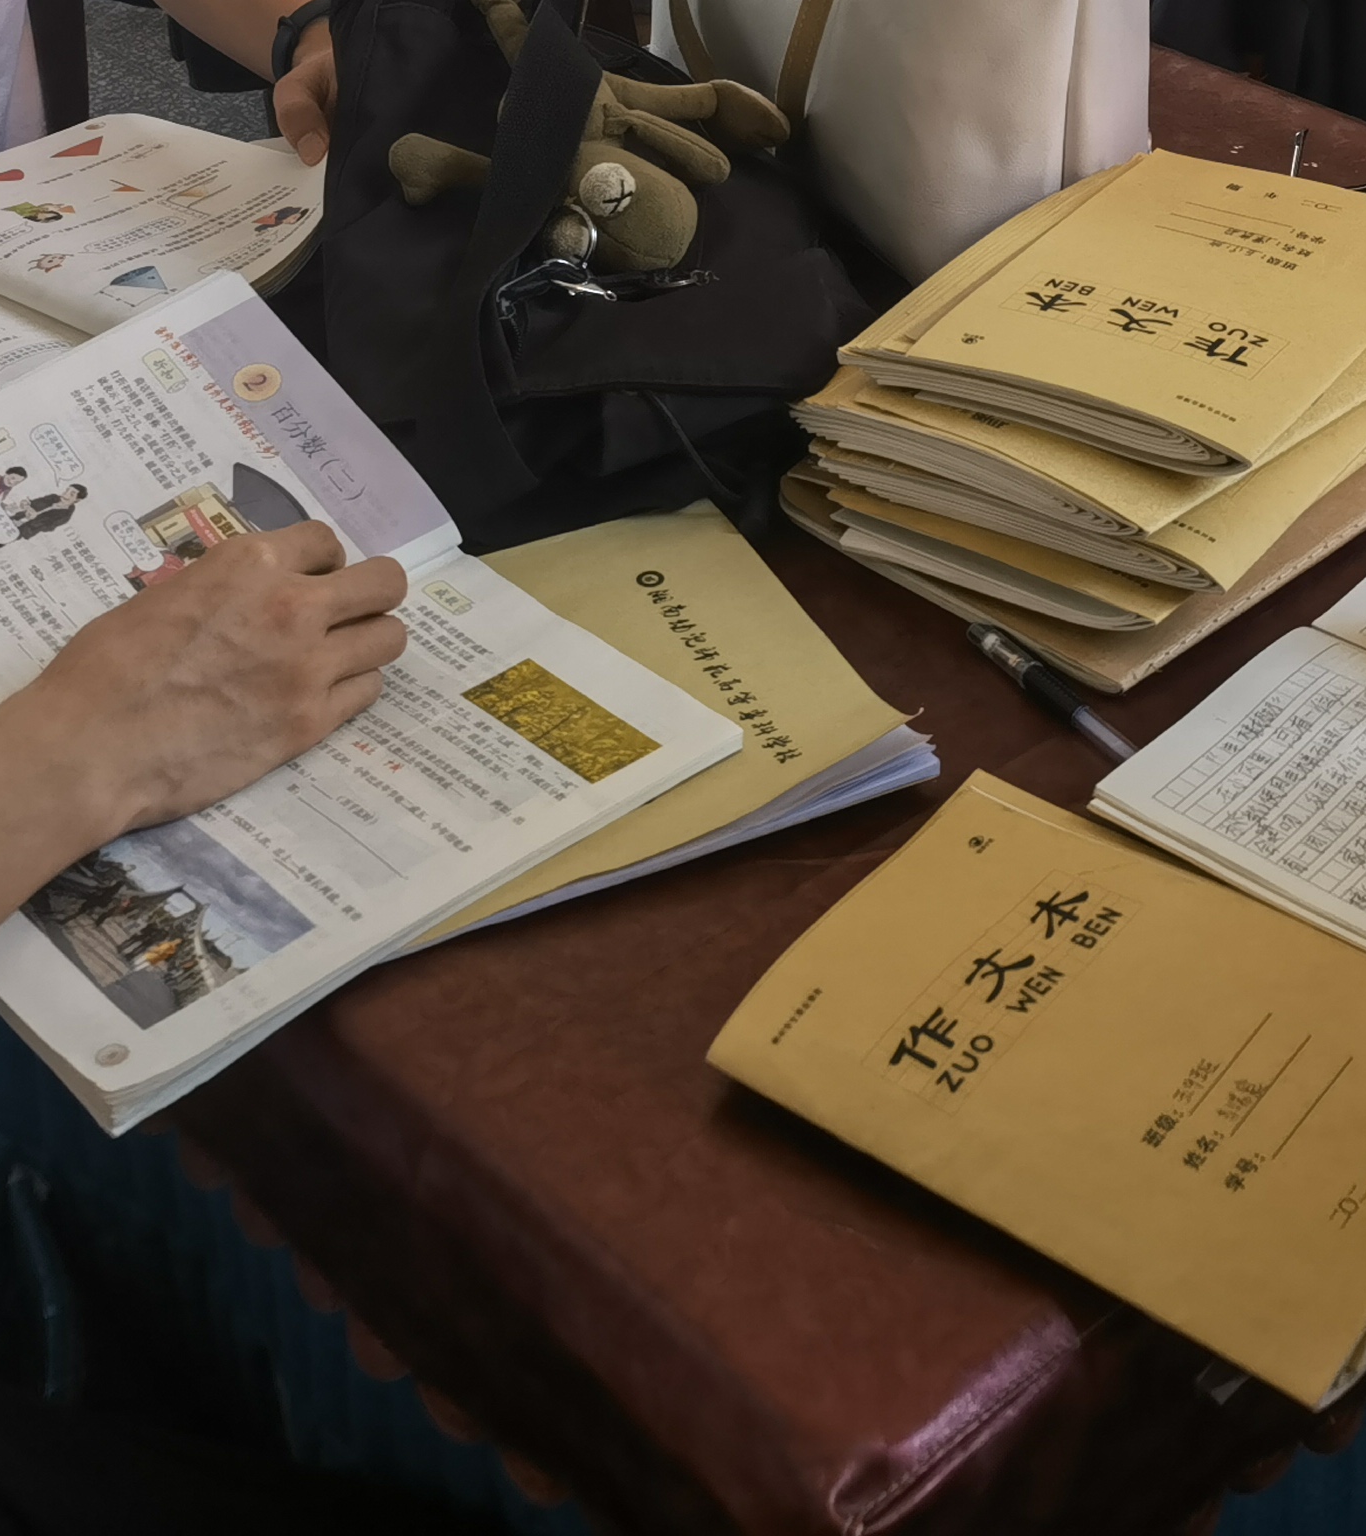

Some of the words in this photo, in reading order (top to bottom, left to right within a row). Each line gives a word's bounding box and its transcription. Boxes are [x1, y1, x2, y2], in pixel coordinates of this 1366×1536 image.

[1043, 275, 1096, 297] BEN
[1119, 293, 1180, 319] WEN
[1021, 286, 1252, 368] 作文本
[1205, 318, 1270, 349] ZUO
[241, 371, 269, 393] 2
[888, 888, 1090, 1082] 作文本
[933, 1027, 1001, 1097] ZUO
[1002, 957, 1067, 1024] WEN
[1069, 898, 1125, 956] BEN
